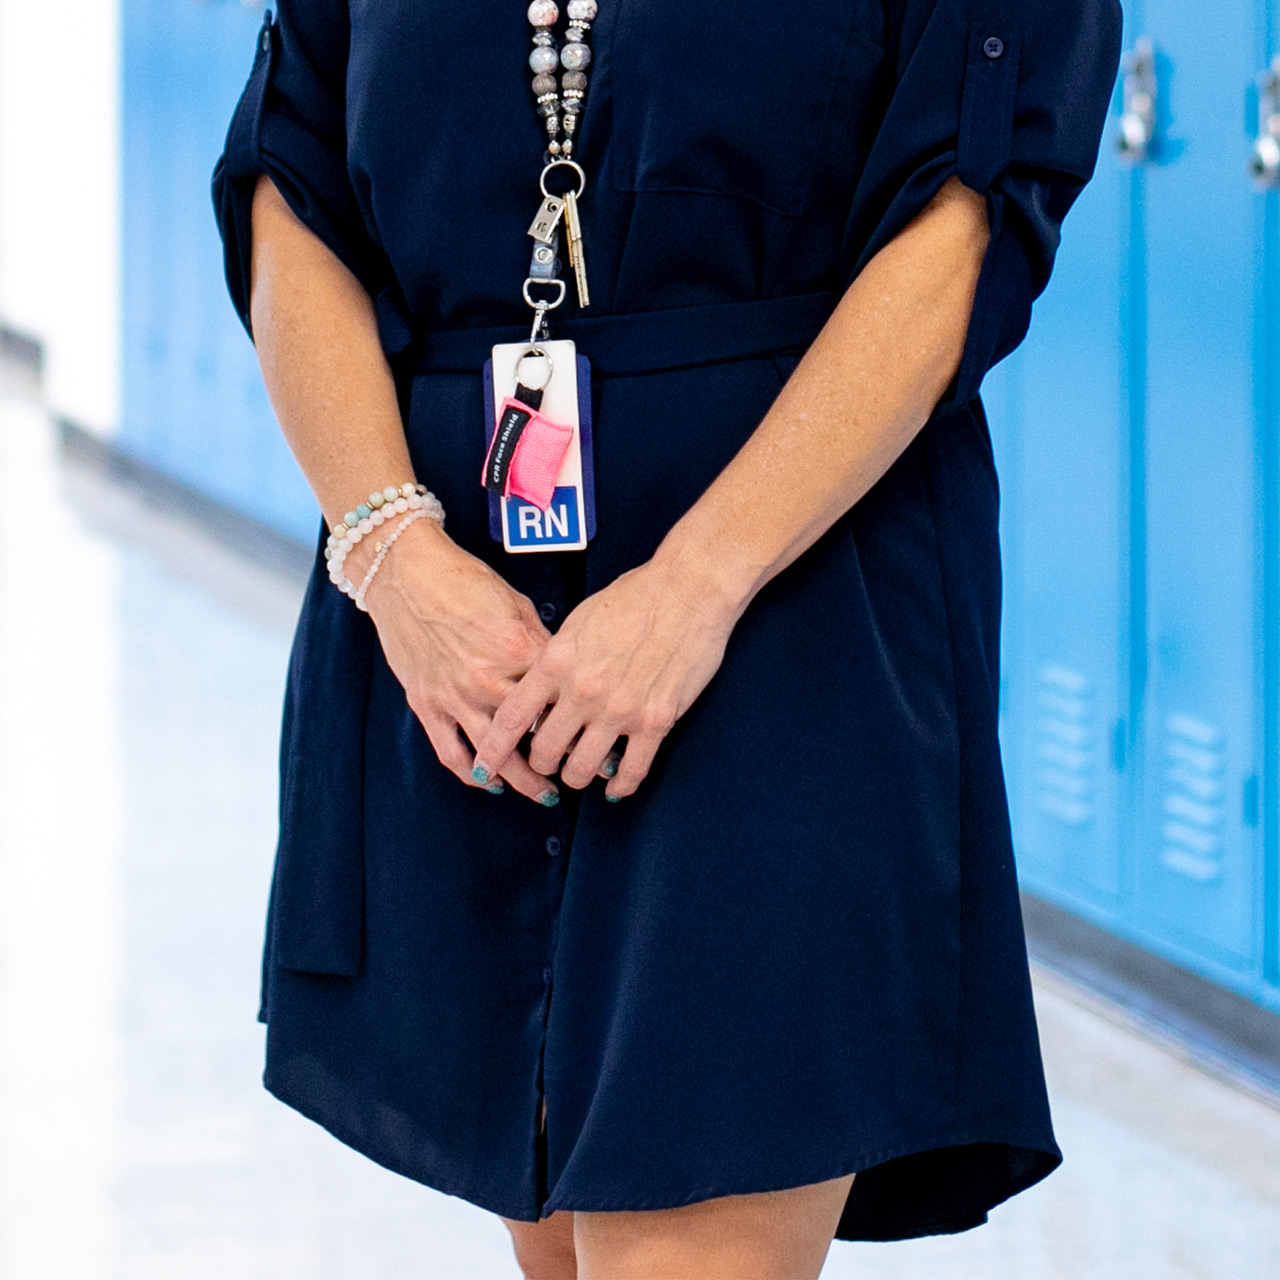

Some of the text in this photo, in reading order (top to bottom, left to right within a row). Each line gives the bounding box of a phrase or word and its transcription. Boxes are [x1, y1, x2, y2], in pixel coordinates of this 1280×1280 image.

[493, 413, 519, 483] CPR Face Shield
[518, 504, 569, 539] RN
